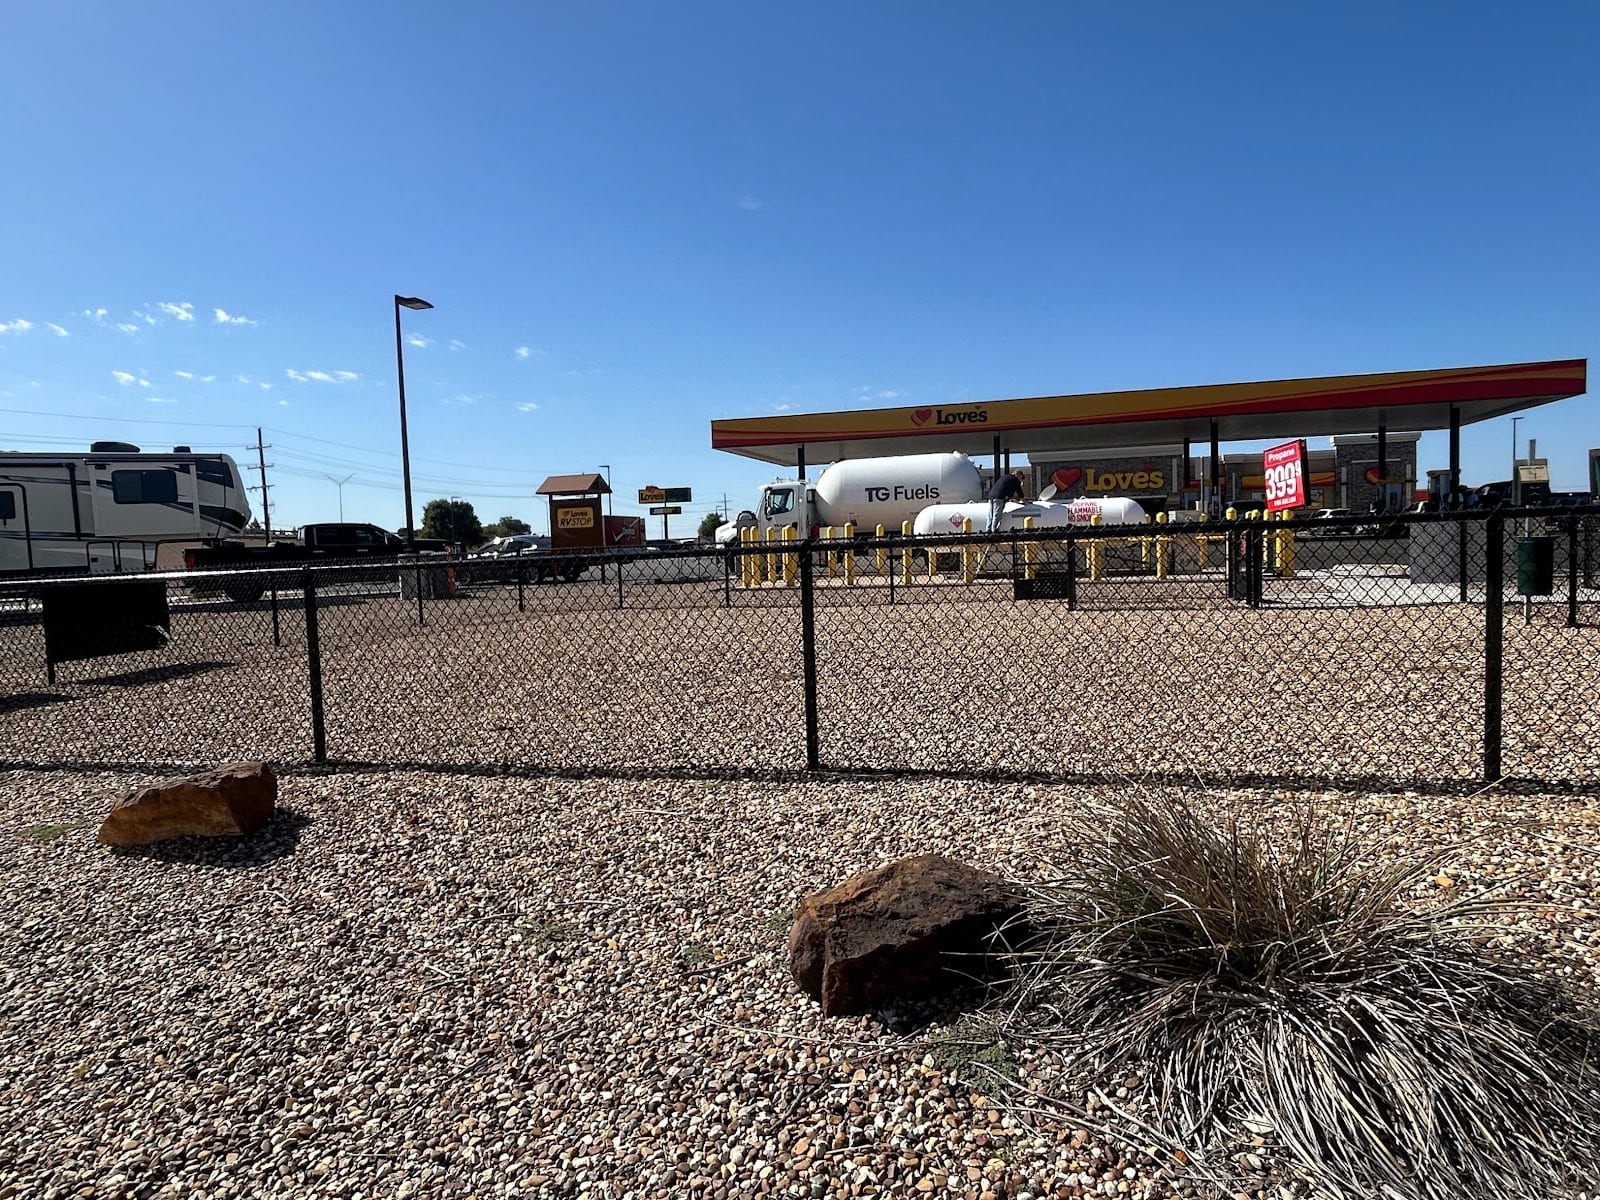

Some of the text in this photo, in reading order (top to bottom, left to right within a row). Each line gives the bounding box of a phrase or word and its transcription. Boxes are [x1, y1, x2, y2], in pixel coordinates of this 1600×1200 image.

[1267, 448, 1296, 462] Propane
[864, 484, 940, 502] TG Fuels
[1067, 506, 1103, 514] FLAMMABLE
[1067, 514, 1076, 522] NO
